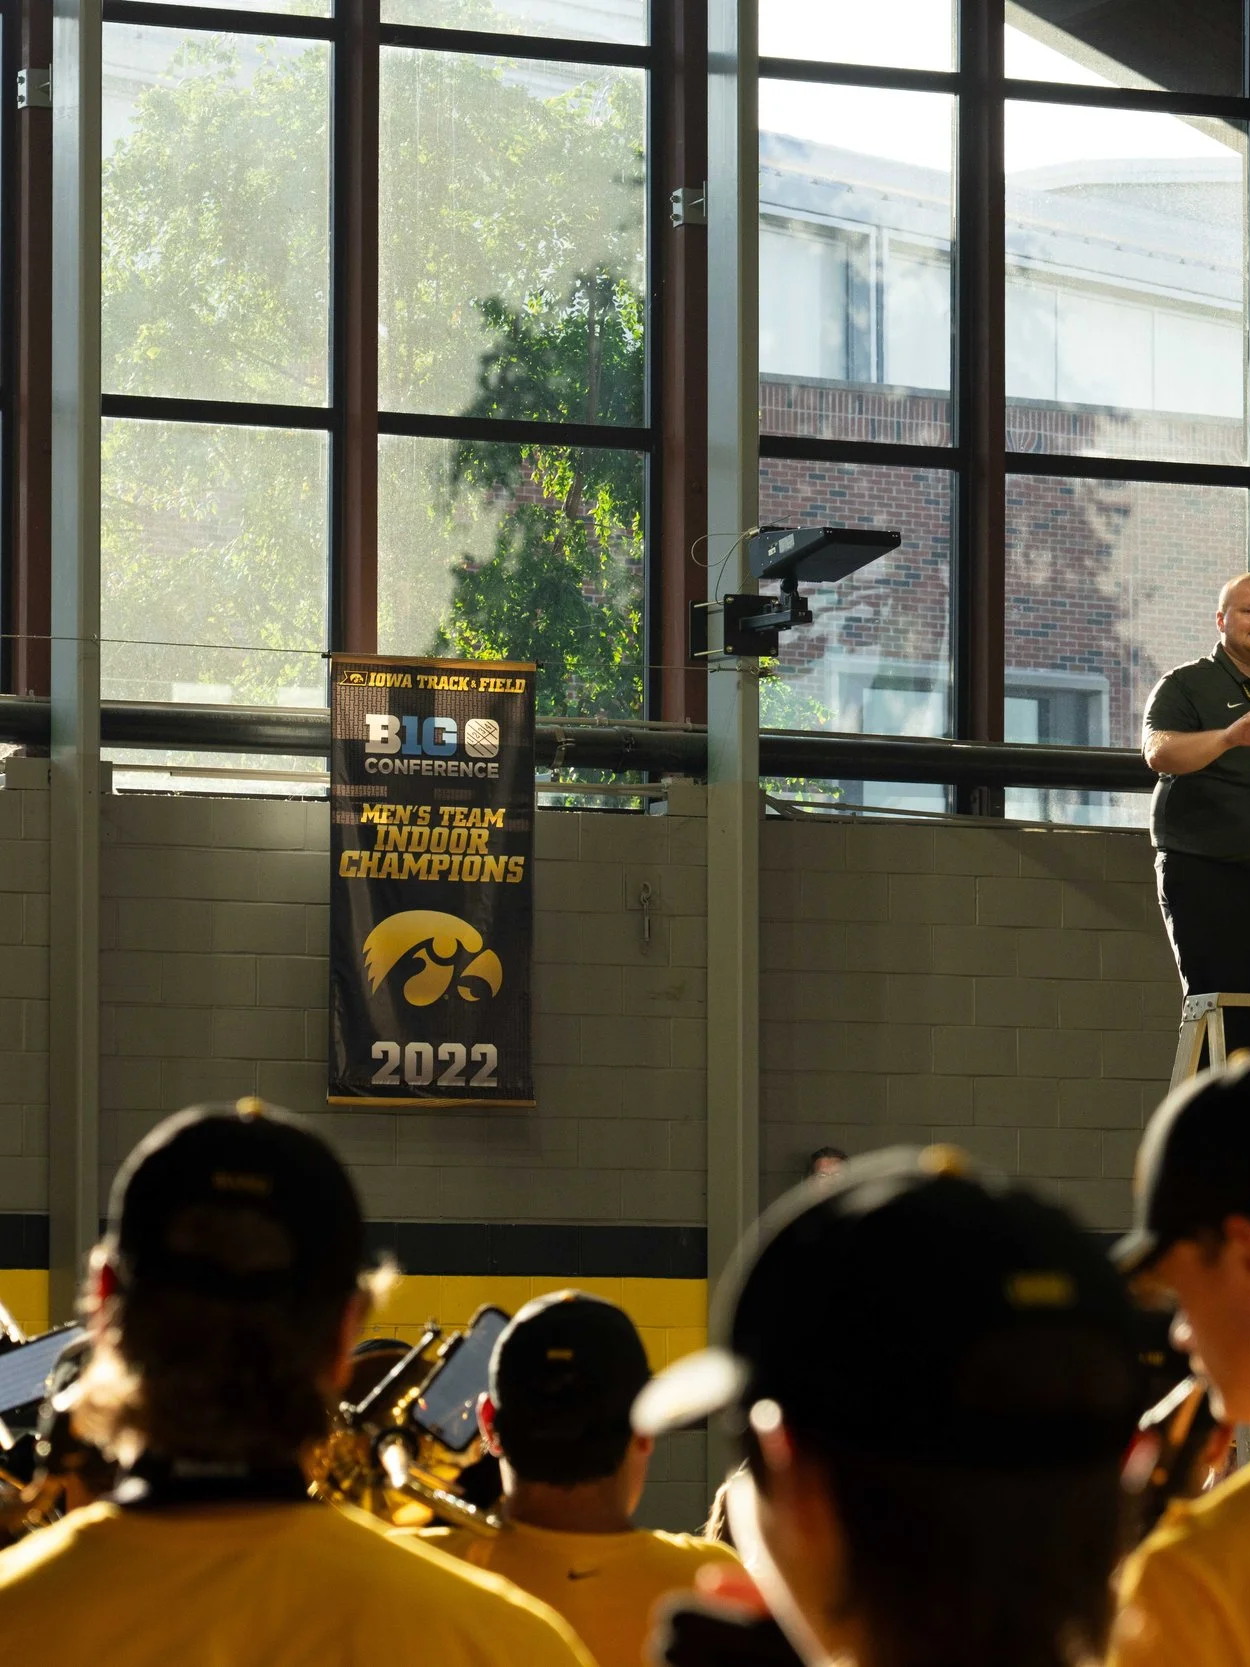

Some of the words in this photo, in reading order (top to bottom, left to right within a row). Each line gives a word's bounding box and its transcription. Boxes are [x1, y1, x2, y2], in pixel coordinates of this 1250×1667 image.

[368, 672, 413, 689] IOWA
[416, 674, 470, 692] TRACK
[478, 677, 527, 694] FIELD
[364, 757, 500, 779] CONFERENCE
[360, 803, 432, 826] MEN'S
[438, 806, 506, 828] TEAM
[374, 825, 490, 855] INDOOR
[339, 851, 525, 883] CHAMPIONS
[371, 1040, 498, 1088] 2022
